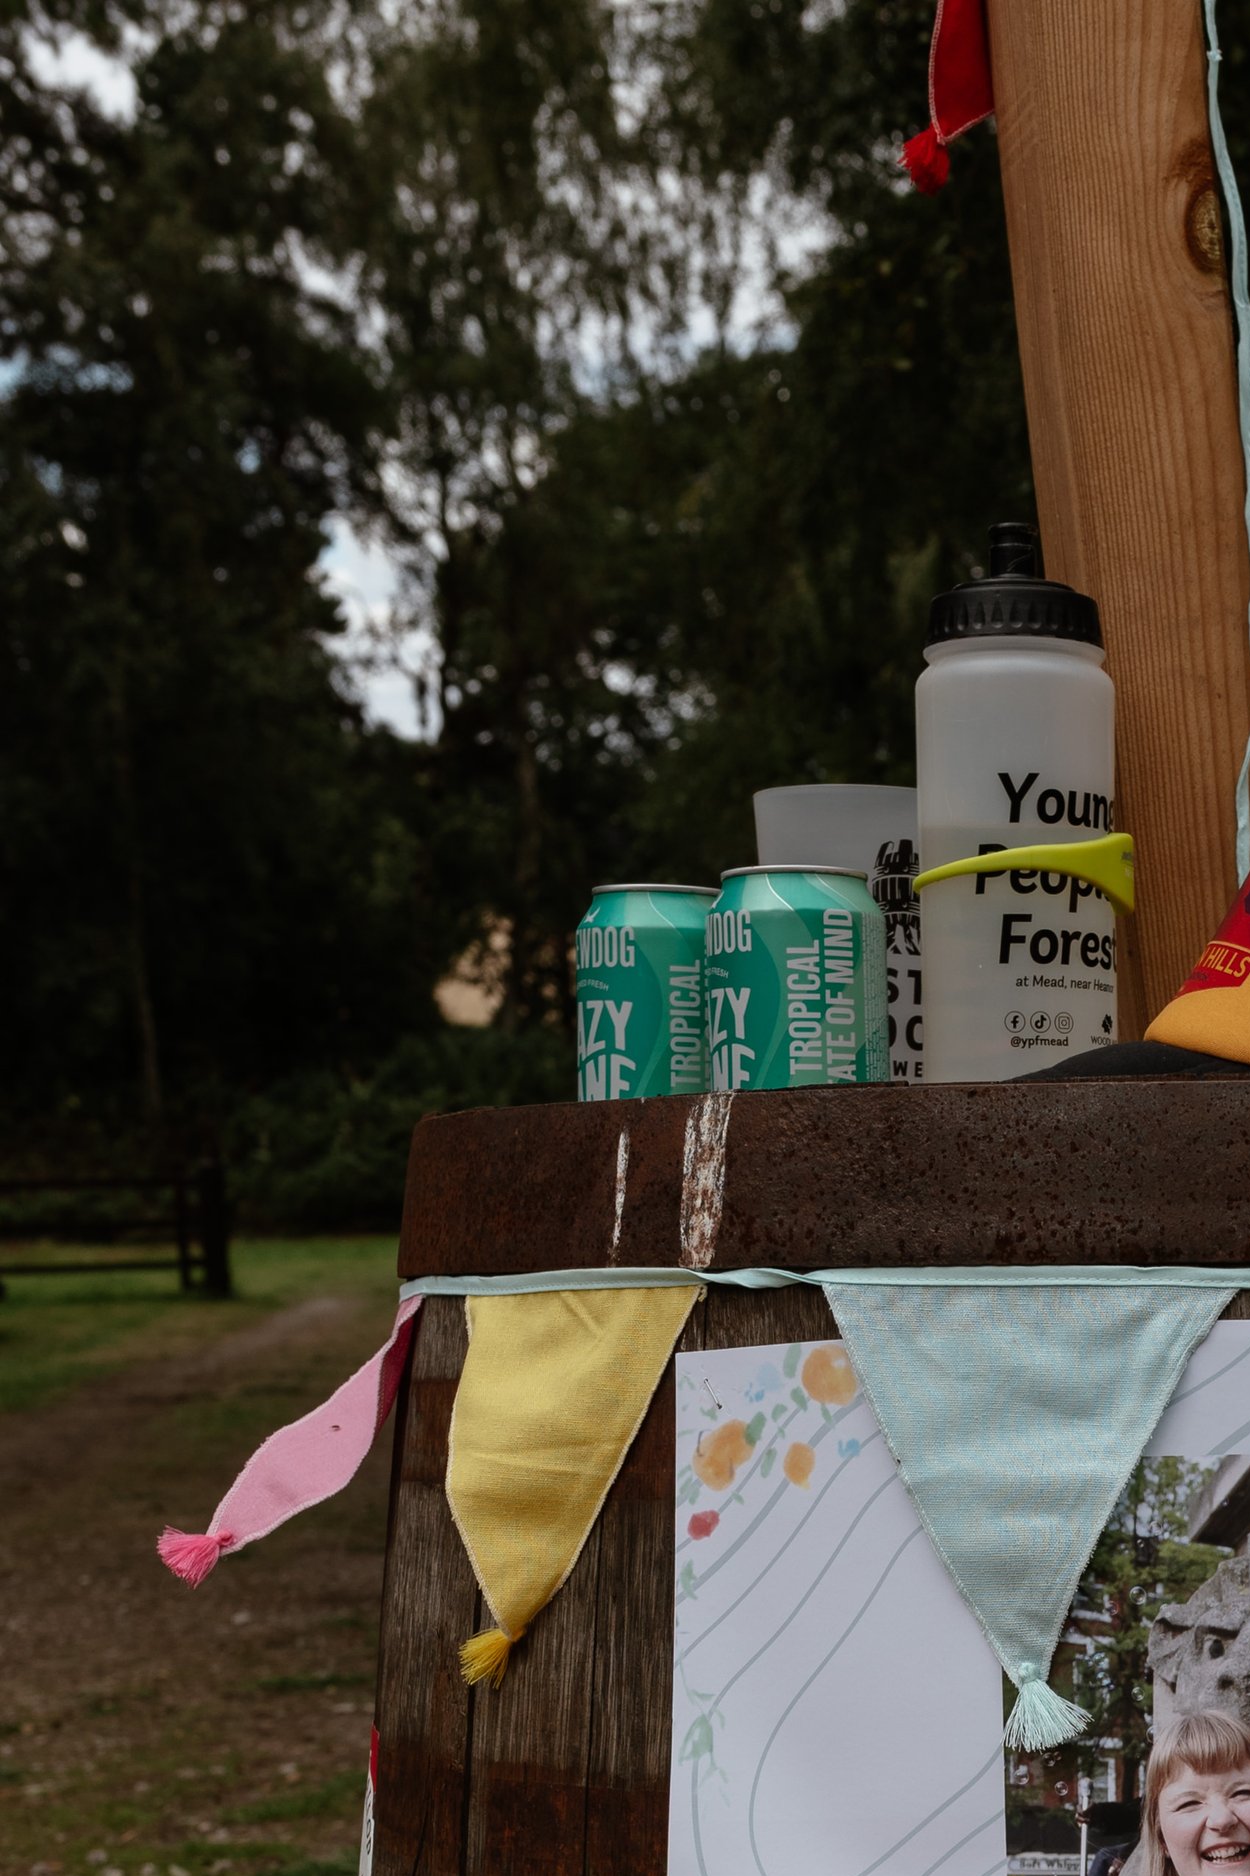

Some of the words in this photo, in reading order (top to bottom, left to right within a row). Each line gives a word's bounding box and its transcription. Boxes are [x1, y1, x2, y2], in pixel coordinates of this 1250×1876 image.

[975, 844, 1110, 913] Peop
[823, 908, 854, 984] MIND
[786, 939, 823, 1075] TROPICAL
[825, 989, 856, 1025] OF
[1015, 975, 1029, 987] at
[1032, 974, 1068, 990] Mead,
[1070, 979, 1091, 990] near
[669, 959, 701, 1088] TROPICAL
[1010, 1035, 1069, 1049] @ypfmead
